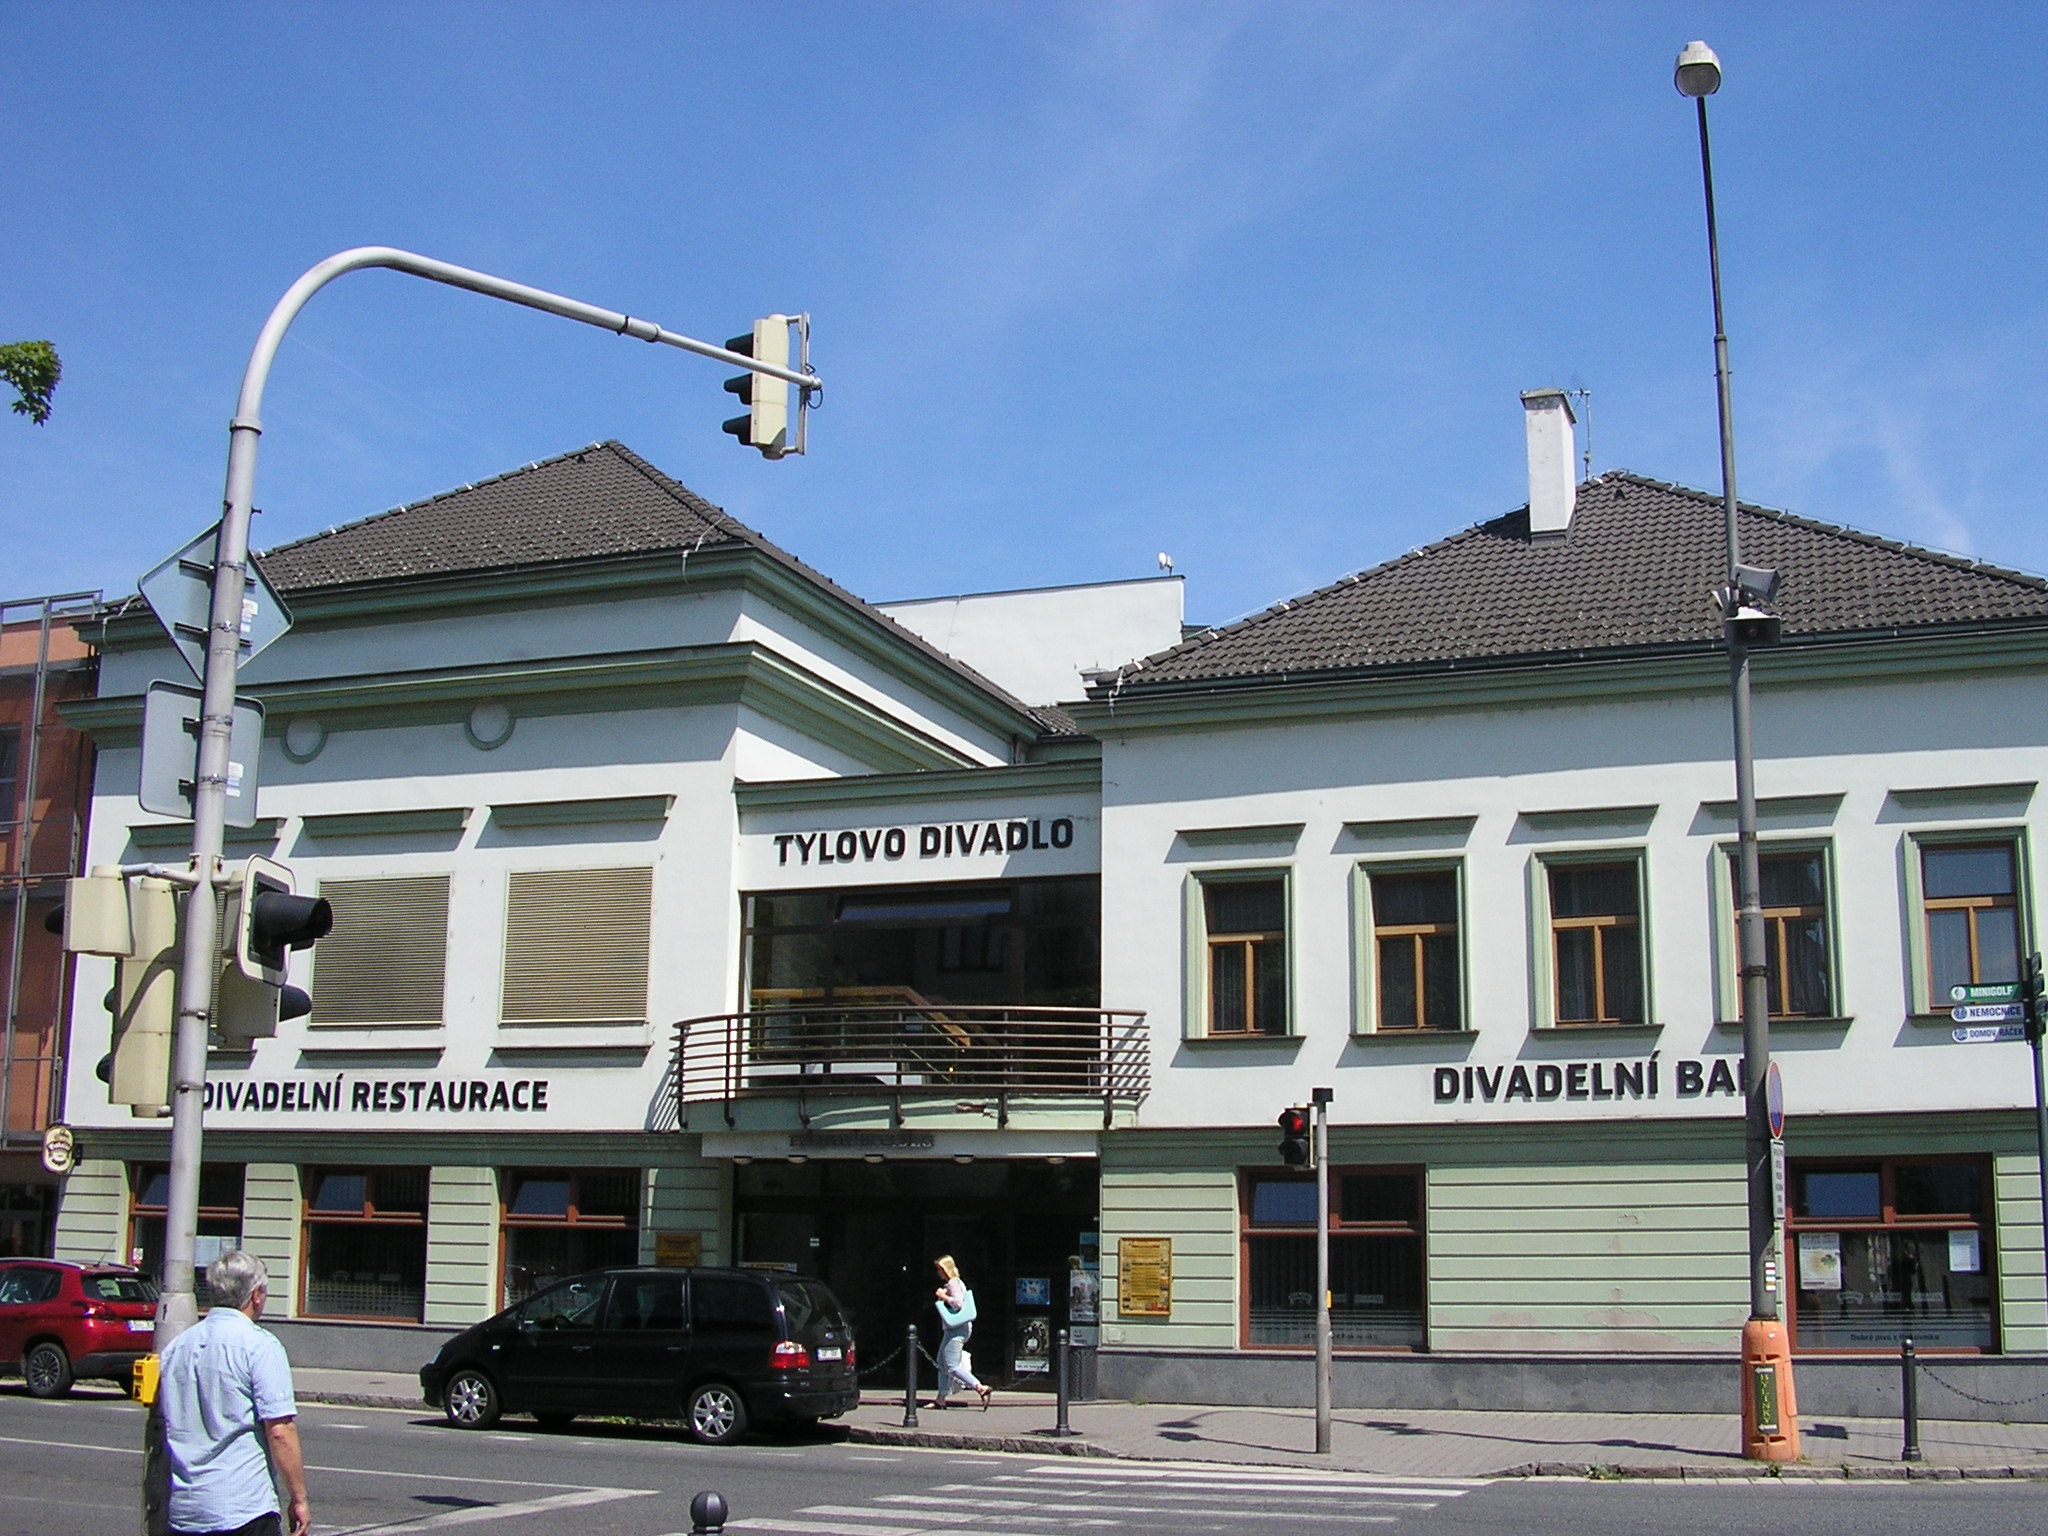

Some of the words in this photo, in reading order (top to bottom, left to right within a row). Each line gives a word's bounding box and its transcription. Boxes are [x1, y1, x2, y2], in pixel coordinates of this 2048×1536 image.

[774, 828, 906, 866] TYLOVO
[920, 818, 1074, 857] DIVADLO
[1970, 986, 2013, 998] MINIGOLF
[1970, 1006, 2021, 1017] NEMOCNICE
[1970, 1029, 1997, 1038] DOMOV
[1434, 1050, 1661, 1102] DIVADELNÍ
[352, 1080, 549, 1112] RESTAURACE
